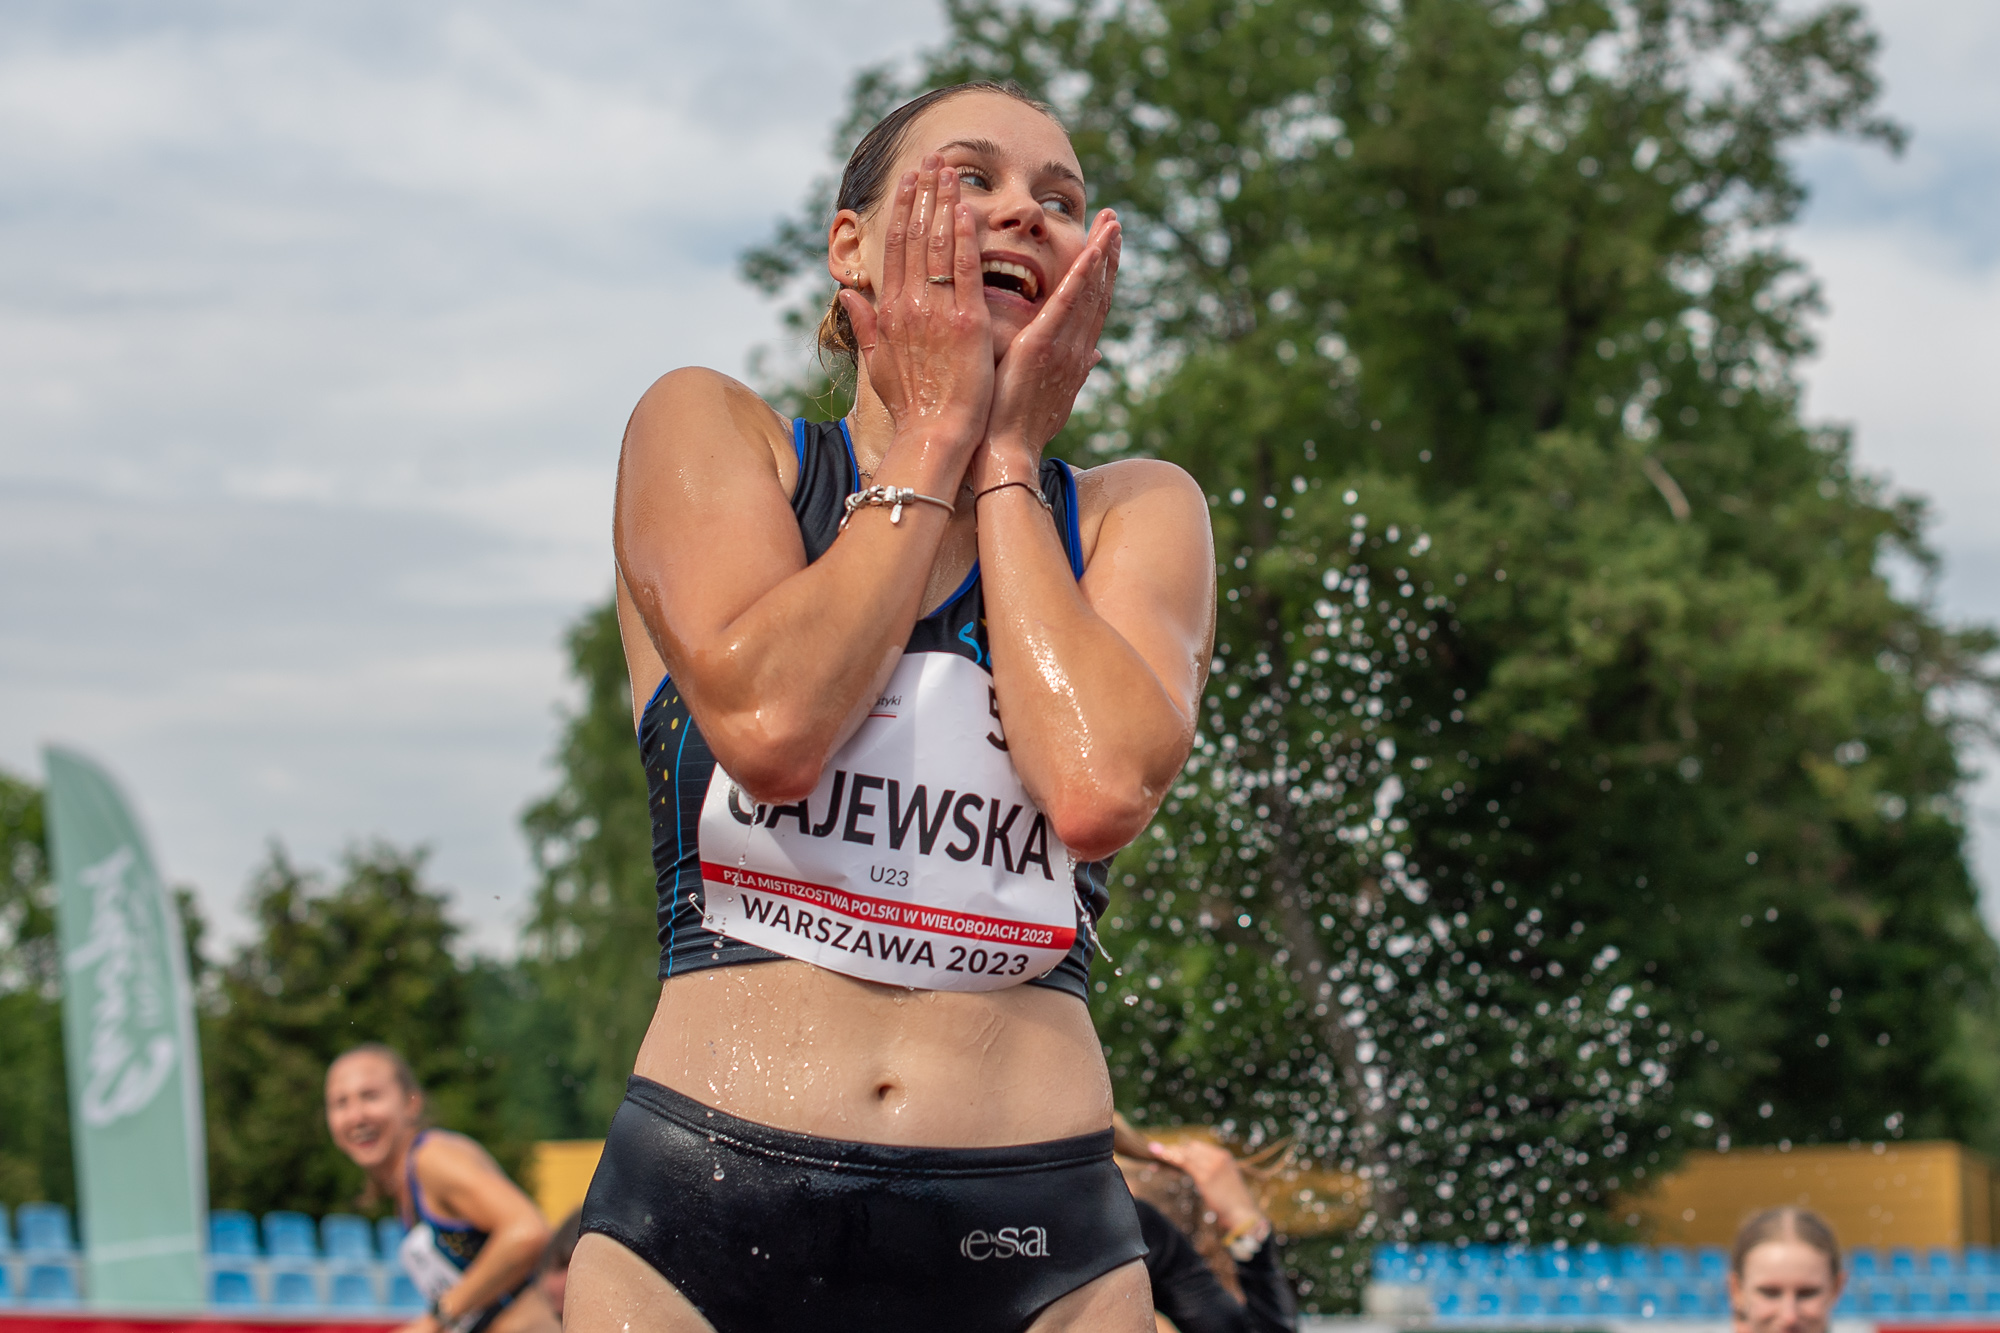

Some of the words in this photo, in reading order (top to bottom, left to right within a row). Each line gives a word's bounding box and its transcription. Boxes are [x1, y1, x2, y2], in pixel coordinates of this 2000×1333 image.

[870, 865, 909, 887] U23
[723, 869, 757, 887] PZLA
[758, 876, 850, 912] MISTRZOSTWA
[851, 900, 900, 922] POLSKI
[903, 908, 919, 925] W
[921, 911, 1019, 941] WIELOBOJACH
[1021, 928, 1053, 945] 2023
[741, 893, 935, 968] WARSZAWA
[945, 945, 1030, 976] 2023
[960, 1226, 1051, 1261] esa
